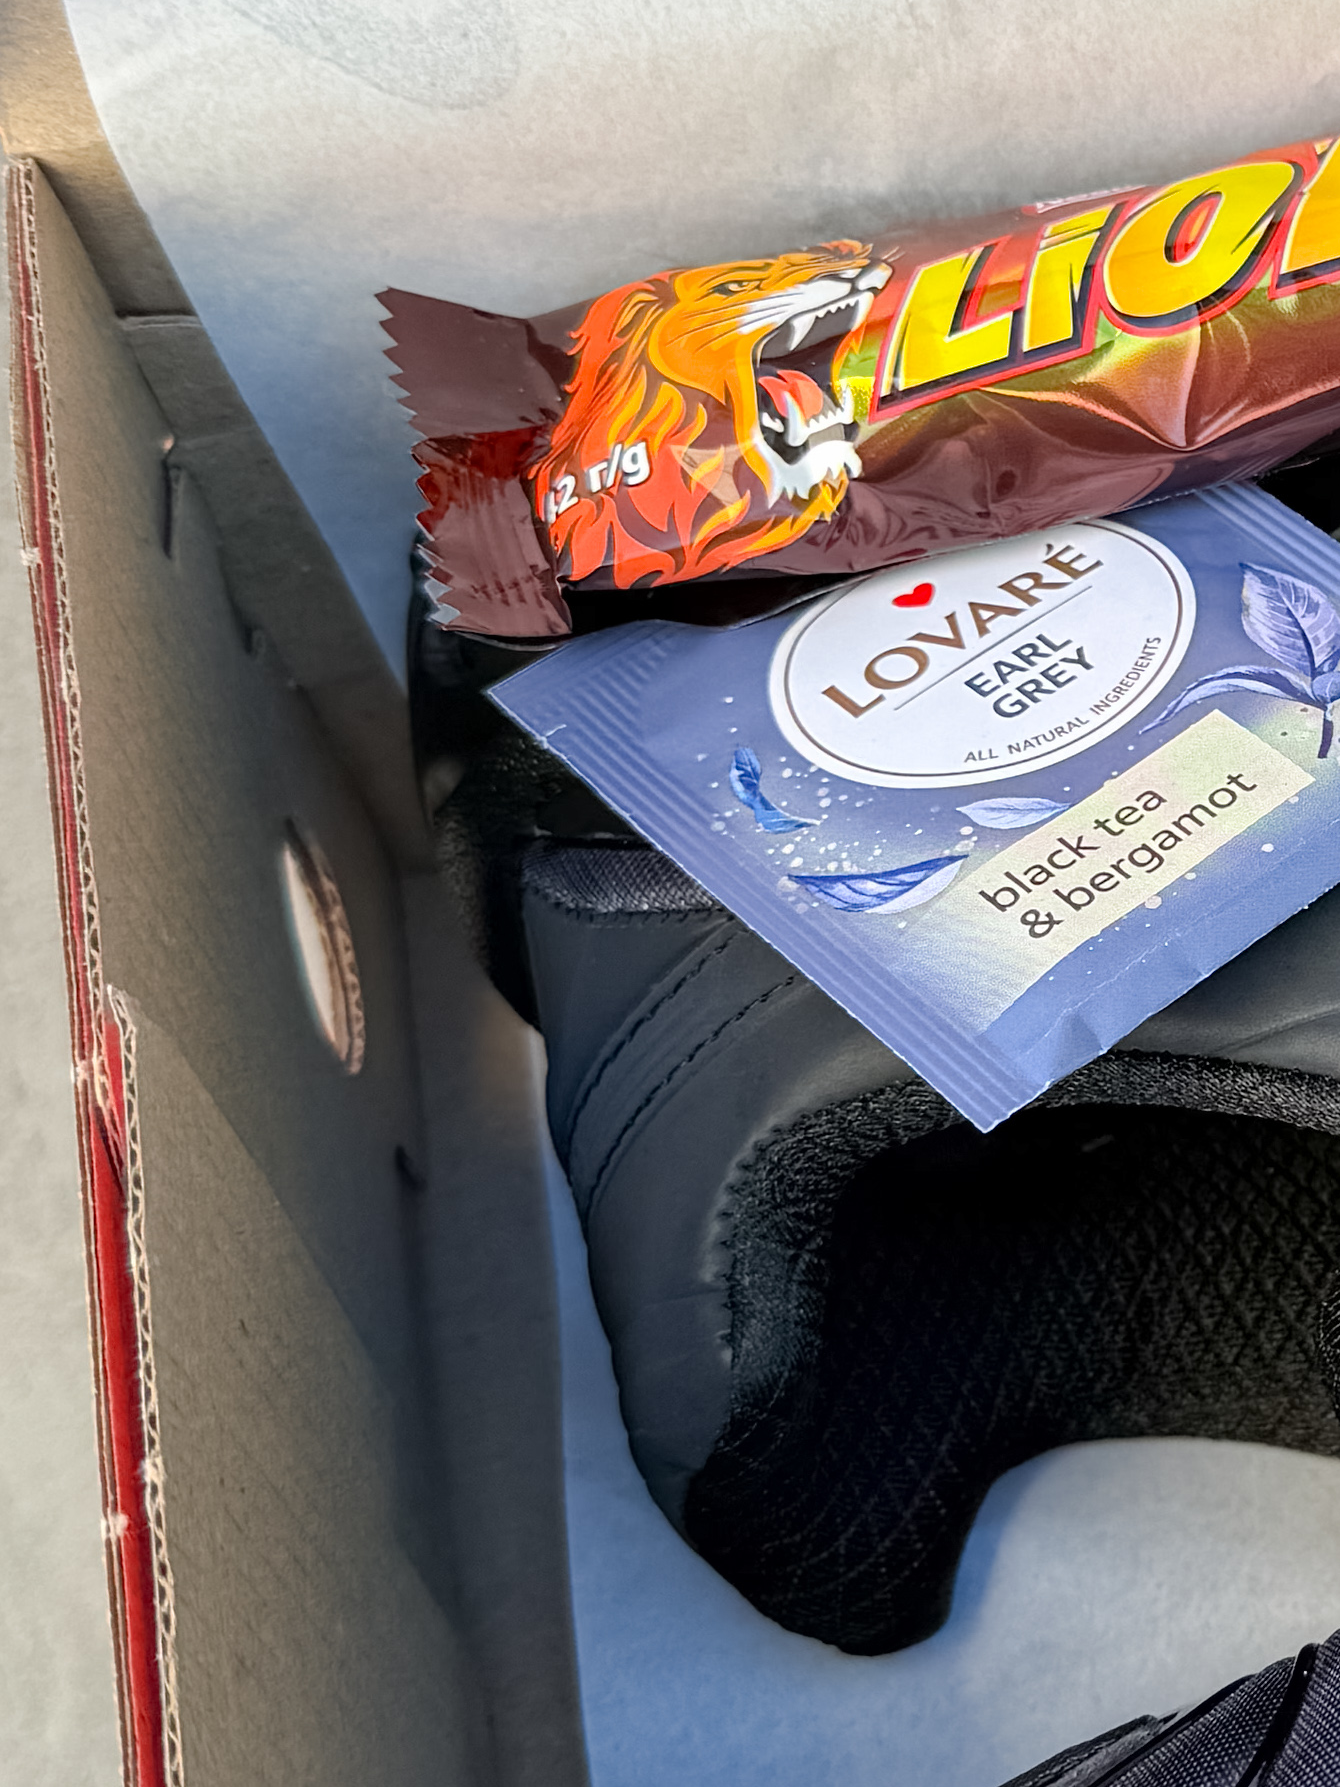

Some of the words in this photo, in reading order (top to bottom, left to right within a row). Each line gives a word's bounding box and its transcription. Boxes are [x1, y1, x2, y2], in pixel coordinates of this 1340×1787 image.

[821, 543, 1104, 719] LOVARÉ
[964, 633, 1074, 698] EARL
[992, 645, 1095, 719] GREY
[963, 748, 1000, 763] ALL
[1007, 716, 1090, 755] NATURAL
[1089, 636, 1162, 716] INGREDIENTS
[979, 834, 1101, 913] black
[1093, 789, 1168, 837] tea
[1020, 908, 1064, 939] &
[1053, 772, 1258, 911] bergamot
